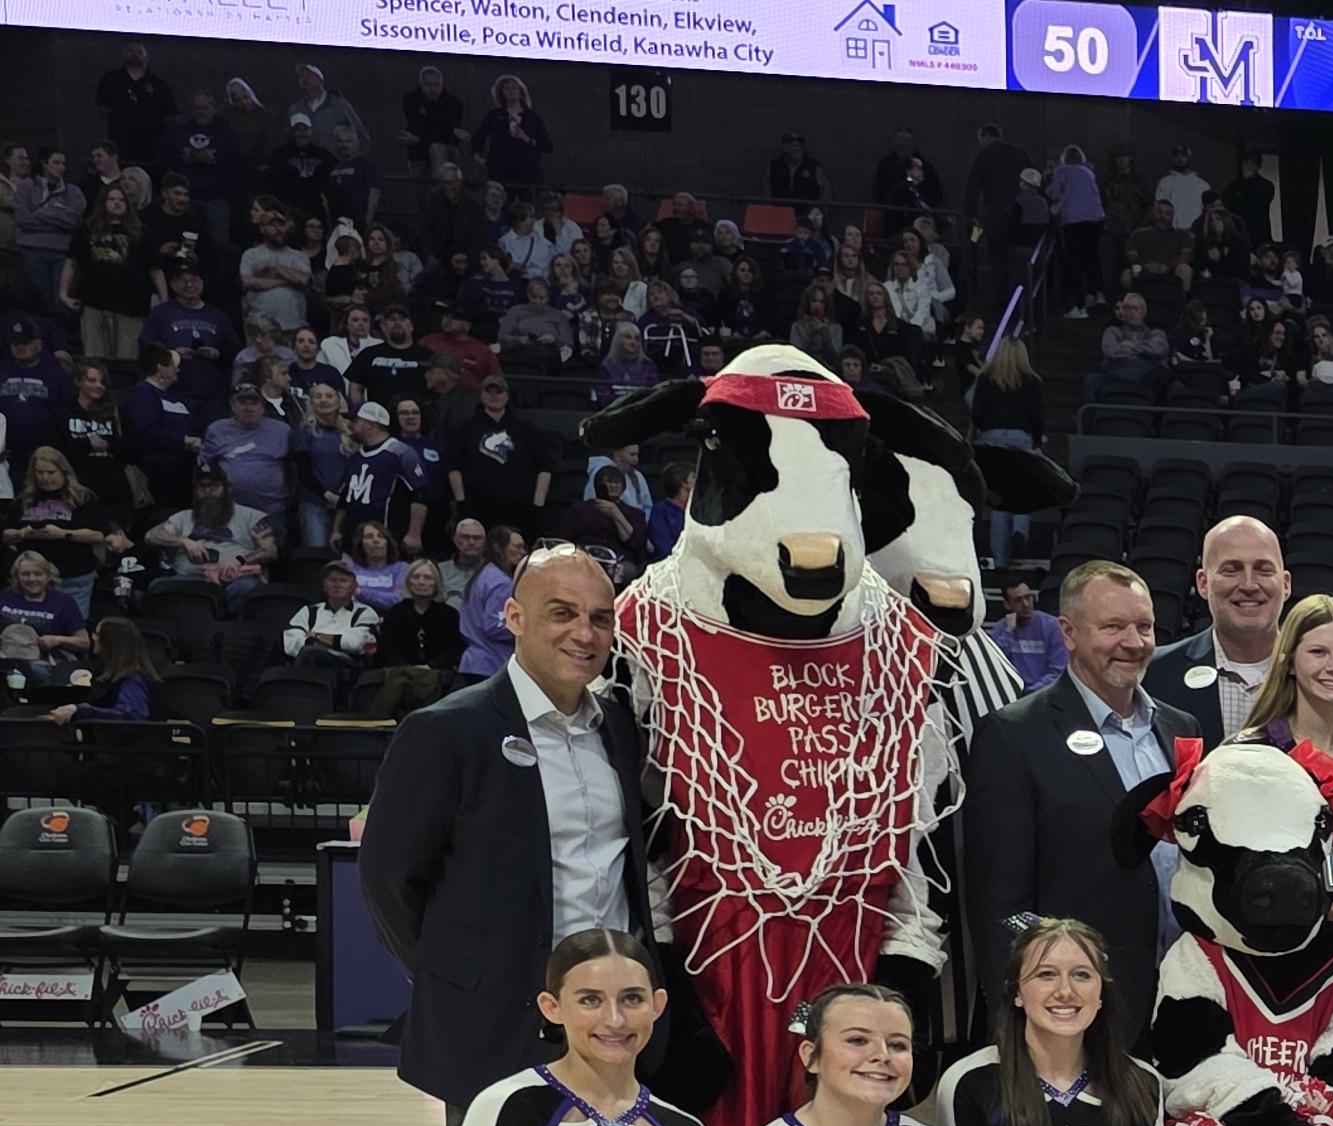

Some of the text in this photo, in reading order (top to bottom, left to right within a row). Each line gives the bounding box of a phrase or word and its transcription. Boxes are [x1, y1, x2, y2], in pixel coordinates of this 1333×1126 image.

[471, 0, 550, 21] Walton,
[556, 3, 667, 30] Clendenin,
[673, 12, 756, 35] Elkview,
[360, 18, 773, 66] Sissonville, Poca Winfield, Kanawha City
[1043, 25, 1109, 74] 50
[615, 84, 667, 119] 130
[769, 662, 855, 691] BLOCK
[788, 725, 855, 755] PASS
[0, 976, 77, 999] hick-fil-A
